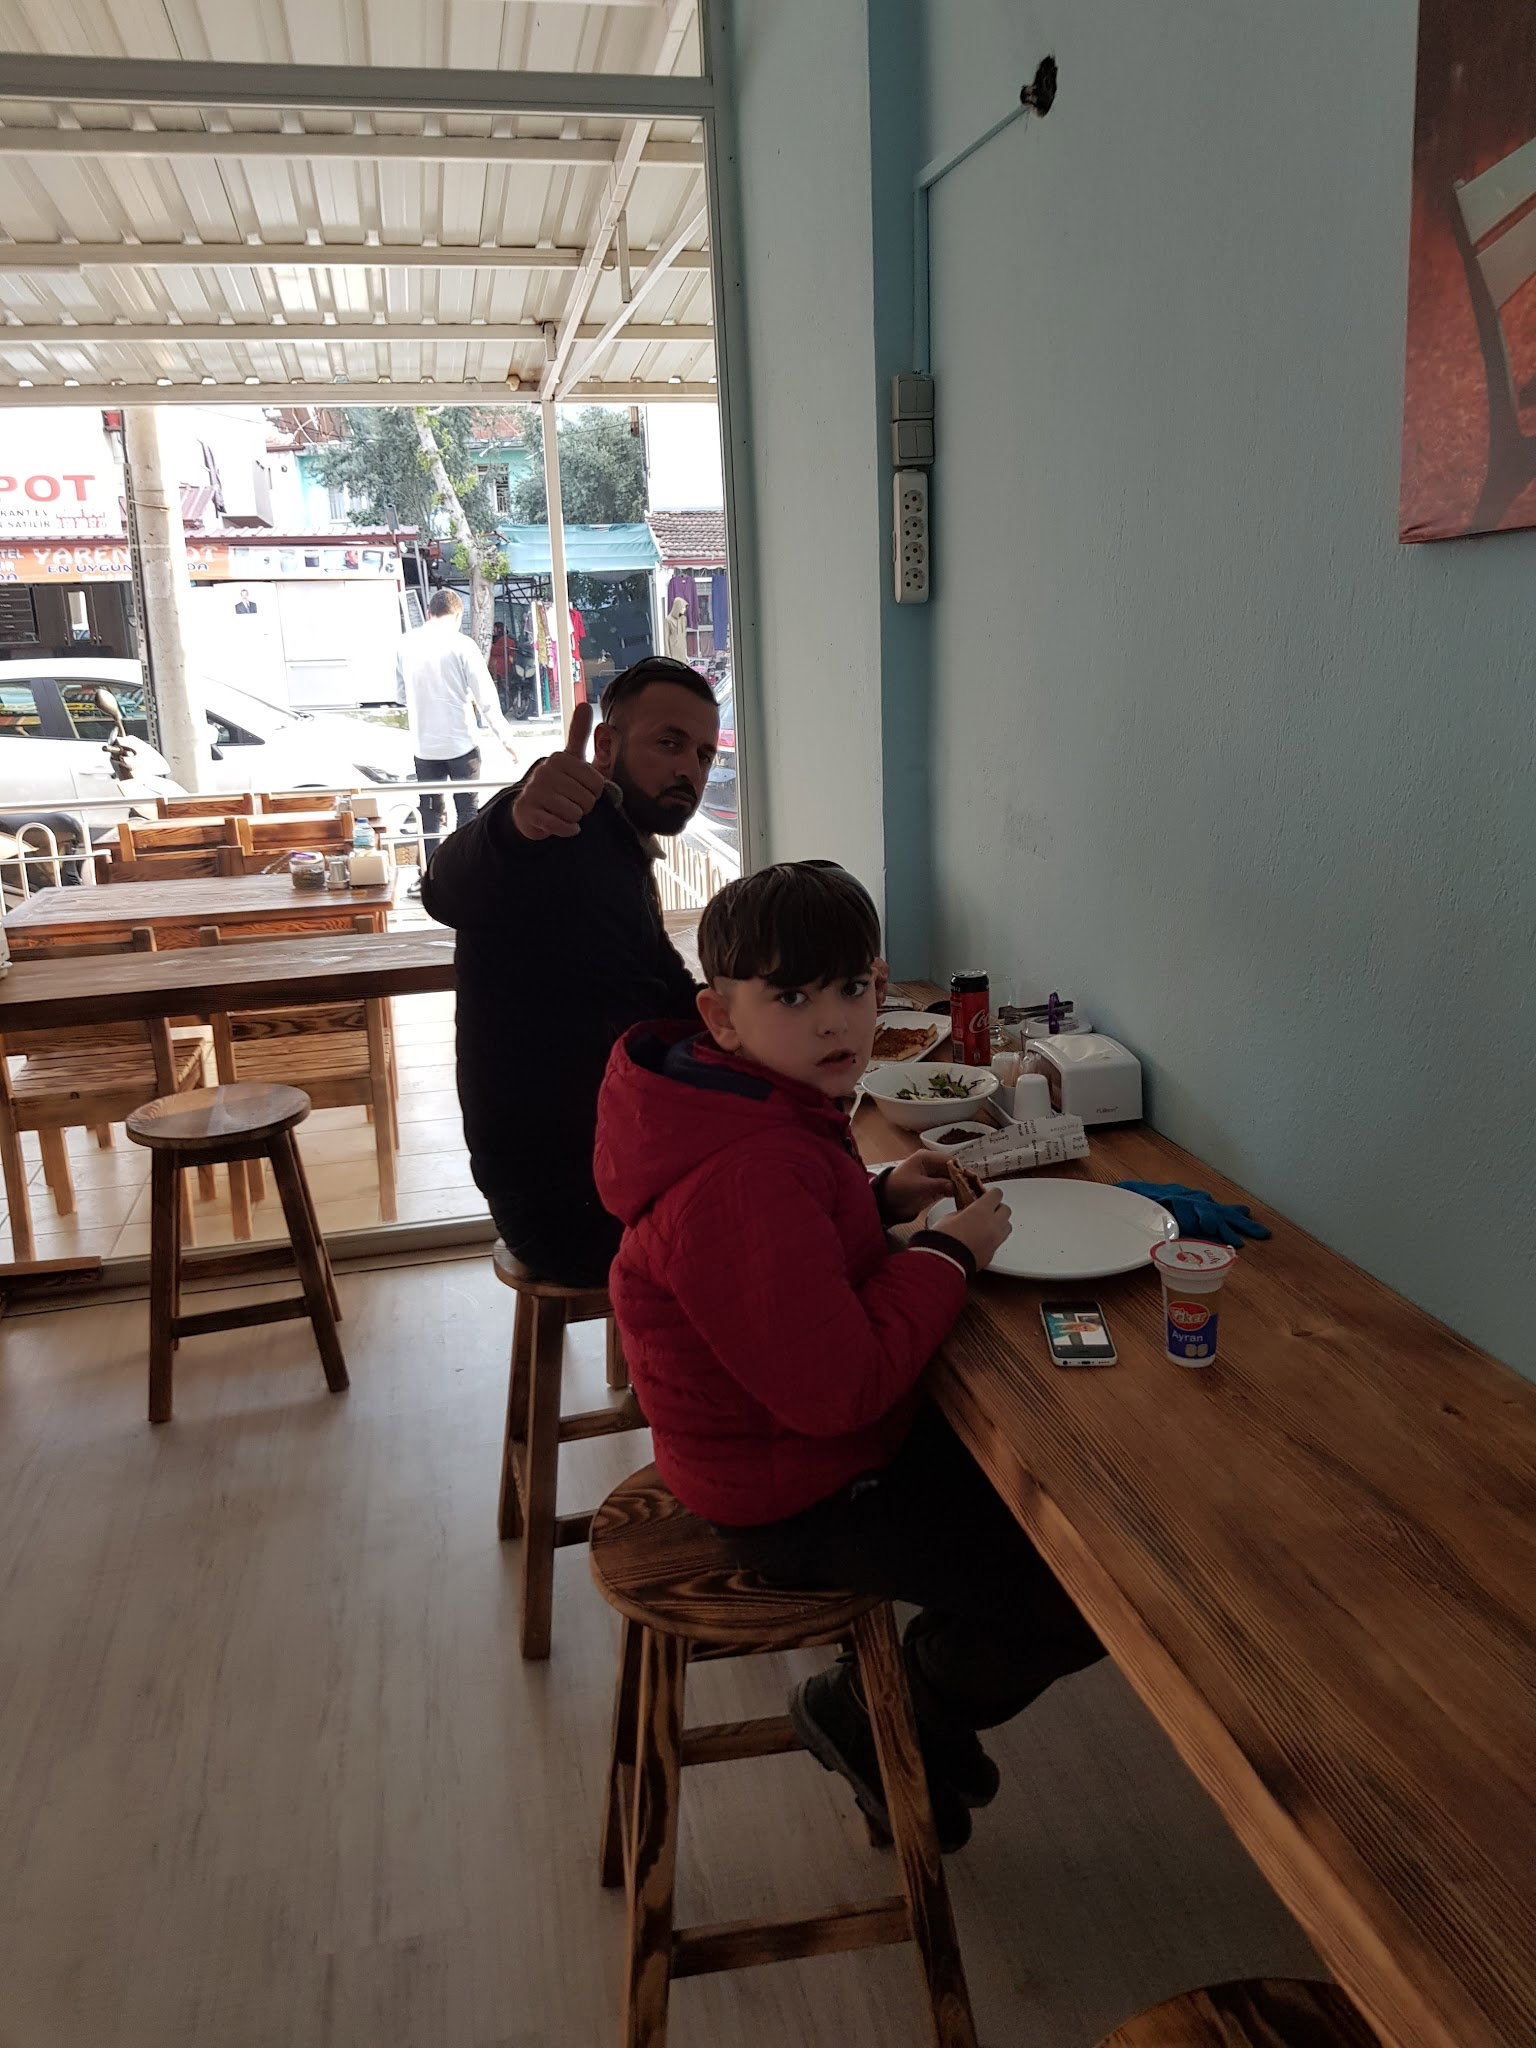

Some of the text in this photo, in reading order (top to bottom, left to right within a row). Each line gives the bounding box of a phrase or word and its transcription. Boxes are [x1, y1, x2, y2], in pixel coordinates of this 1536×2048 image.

[0, 475, 96, 502] POT
[33, 547, 131, 565] YAREN
[48, 565, 69, 573] EN
[1172, 1330, 1204, 1342] Ayran
